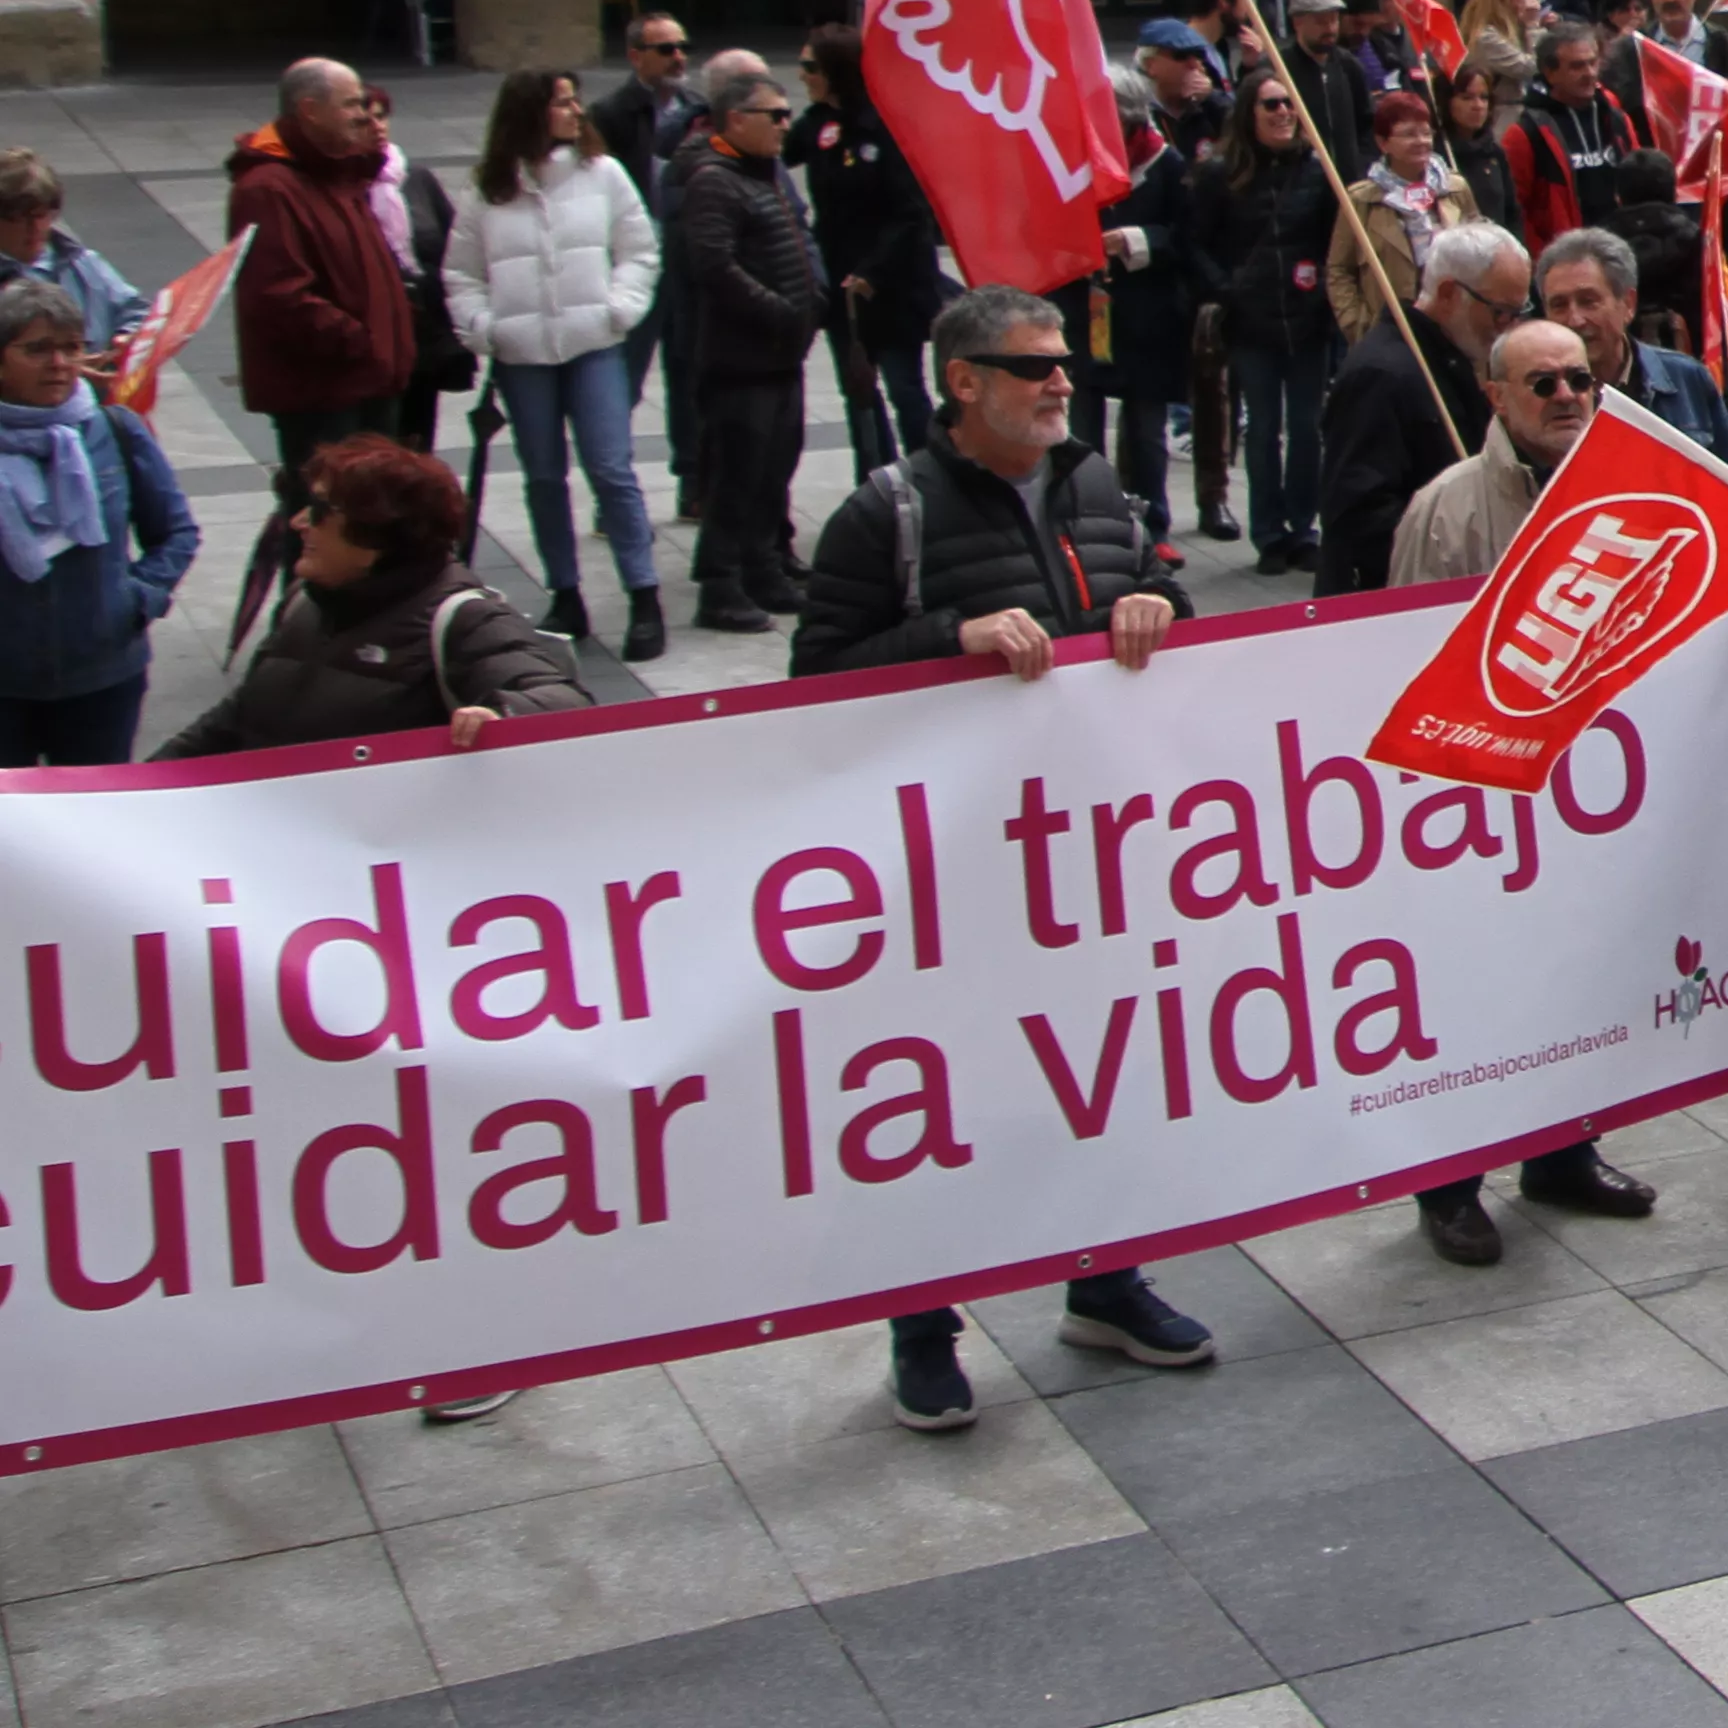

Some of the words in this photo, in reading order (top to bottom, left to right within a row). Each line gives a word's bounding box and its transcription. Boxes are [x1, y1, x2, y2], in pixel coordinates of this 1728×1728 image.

[1497, 512, 1662, 699] UGT
[1411, 713, 1545, 760] www.ugt.es
[24, 861, 682, 1092] uidar
[751, 782, 943, 992] el
[1004, 708, 1647, 950] trabajo
[0, 1065, 706, 1313] uidar
[772, 1007, 974, 1199] la
[1018, 913, 1439, 1142] vida
[1349, 1024, 1629, 1117] #cuidareltrabajocuidarlavida
